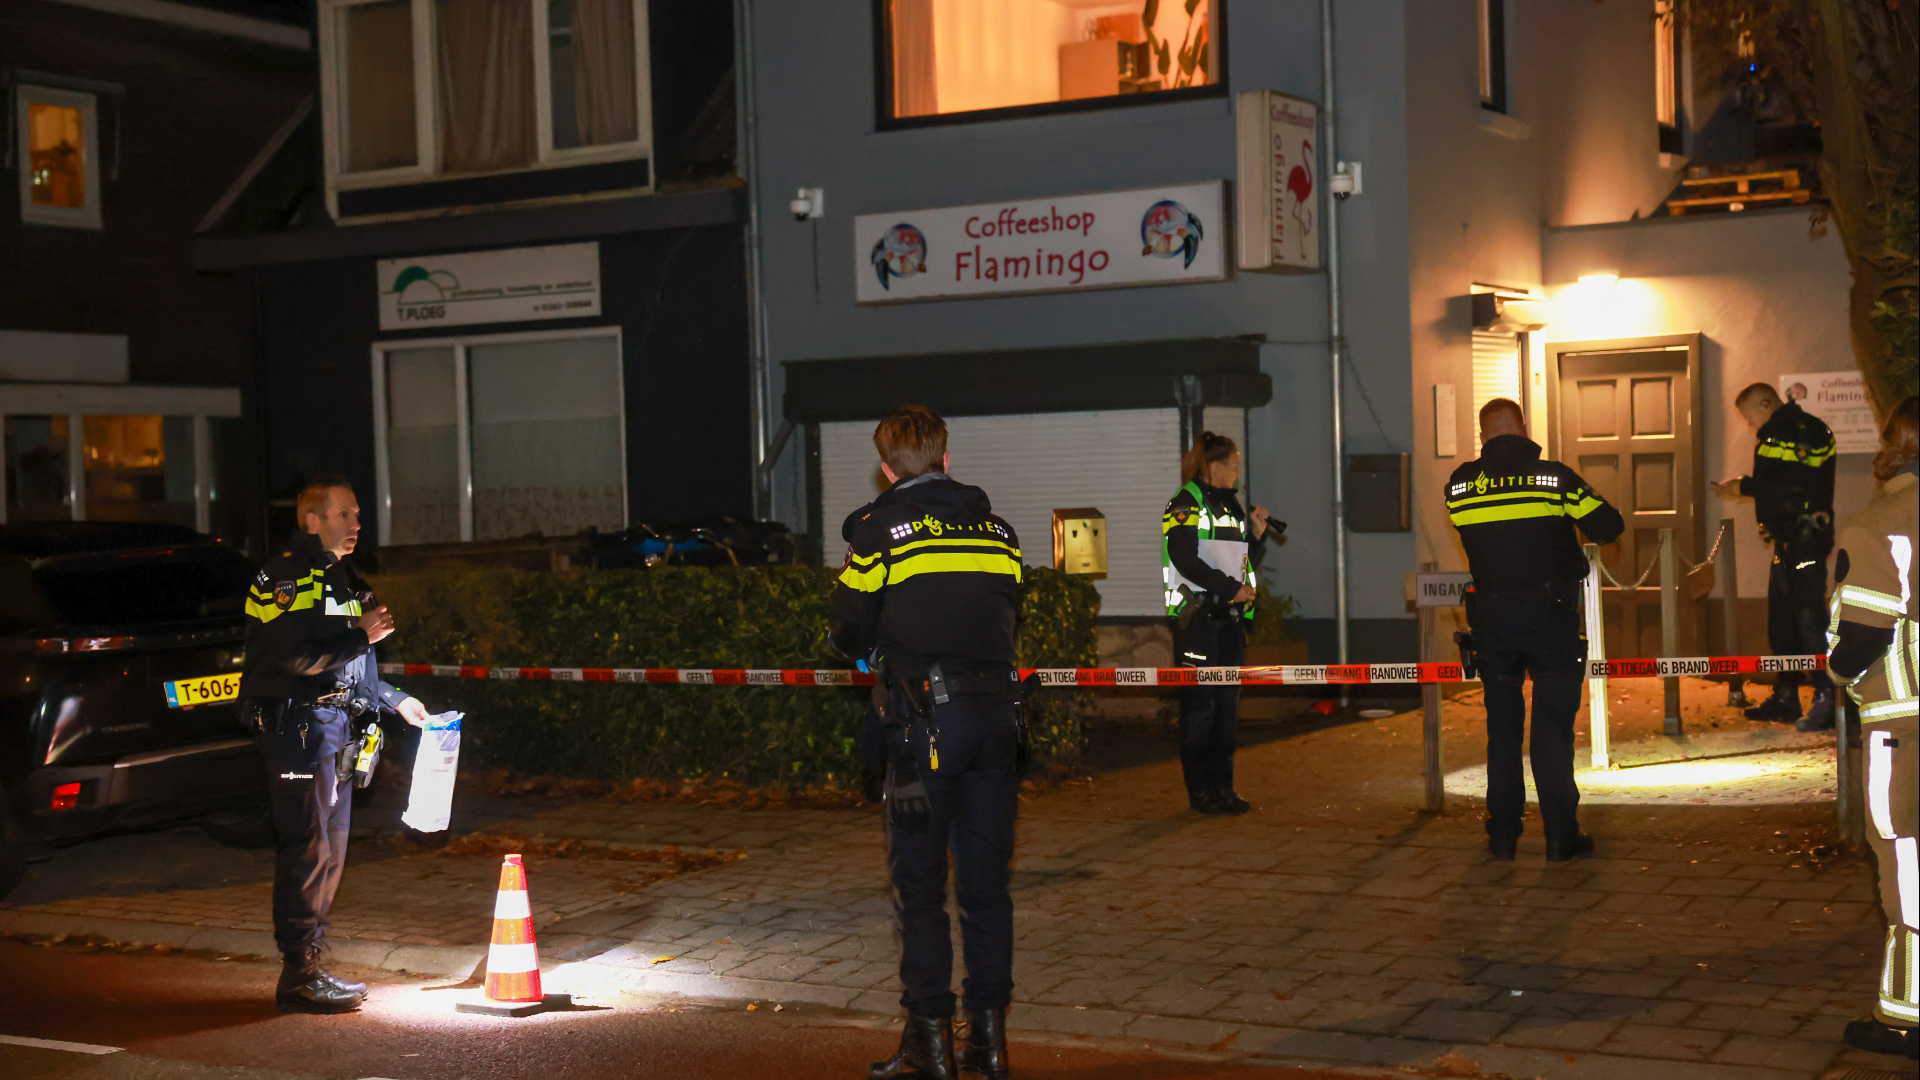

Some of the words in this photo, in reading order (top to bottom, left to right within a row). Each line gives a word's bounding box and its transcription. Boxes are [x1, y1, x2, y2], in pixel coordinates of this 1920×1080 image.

[1271, 103, 1315, 134] Coffeeshop
[965, 206, 1095, 239] Coffeeshop
[955, 246, 1109, 284] Flamingo
[1821, 377, 1863, 389] Coffeesh
[1817, 389, 1871, 404] Flaming
[1467, 471, 1535, 495] POLITIE
[1424, 583, 1468, 596] INGAN
[1591, 663, 1618, 676] GEEN
[1620, 661, 1668, 675] TOEGANG
[1671, 660, 1739, 674] BRANDWEER
[1755, 659, 1783, 671] GEEN
[1785, 658, 1826, 670] TOEGA
[687, 672, 703, 682] GEEN
[741, 672, 785, 683] BRANDWEER
[816, 673, 850, 683] TOEGANG
[1053, 671, 1092, 683] TOEGANG
[1094, 671, 1146, 682] BRANDWEER
[1158, 671, 1181, 682] GEEN
[1183, 670, 1223, 682] TOEGANG
[1294, 669, 1317, 680] GEEN
[1319, 668, 1361, 680] TOEGANG
[1365, 667, 1424, 680] BRANDWEER
[1437, 666, 1462, 679] GEEN
[181, 678, 241, 701] T-606-
